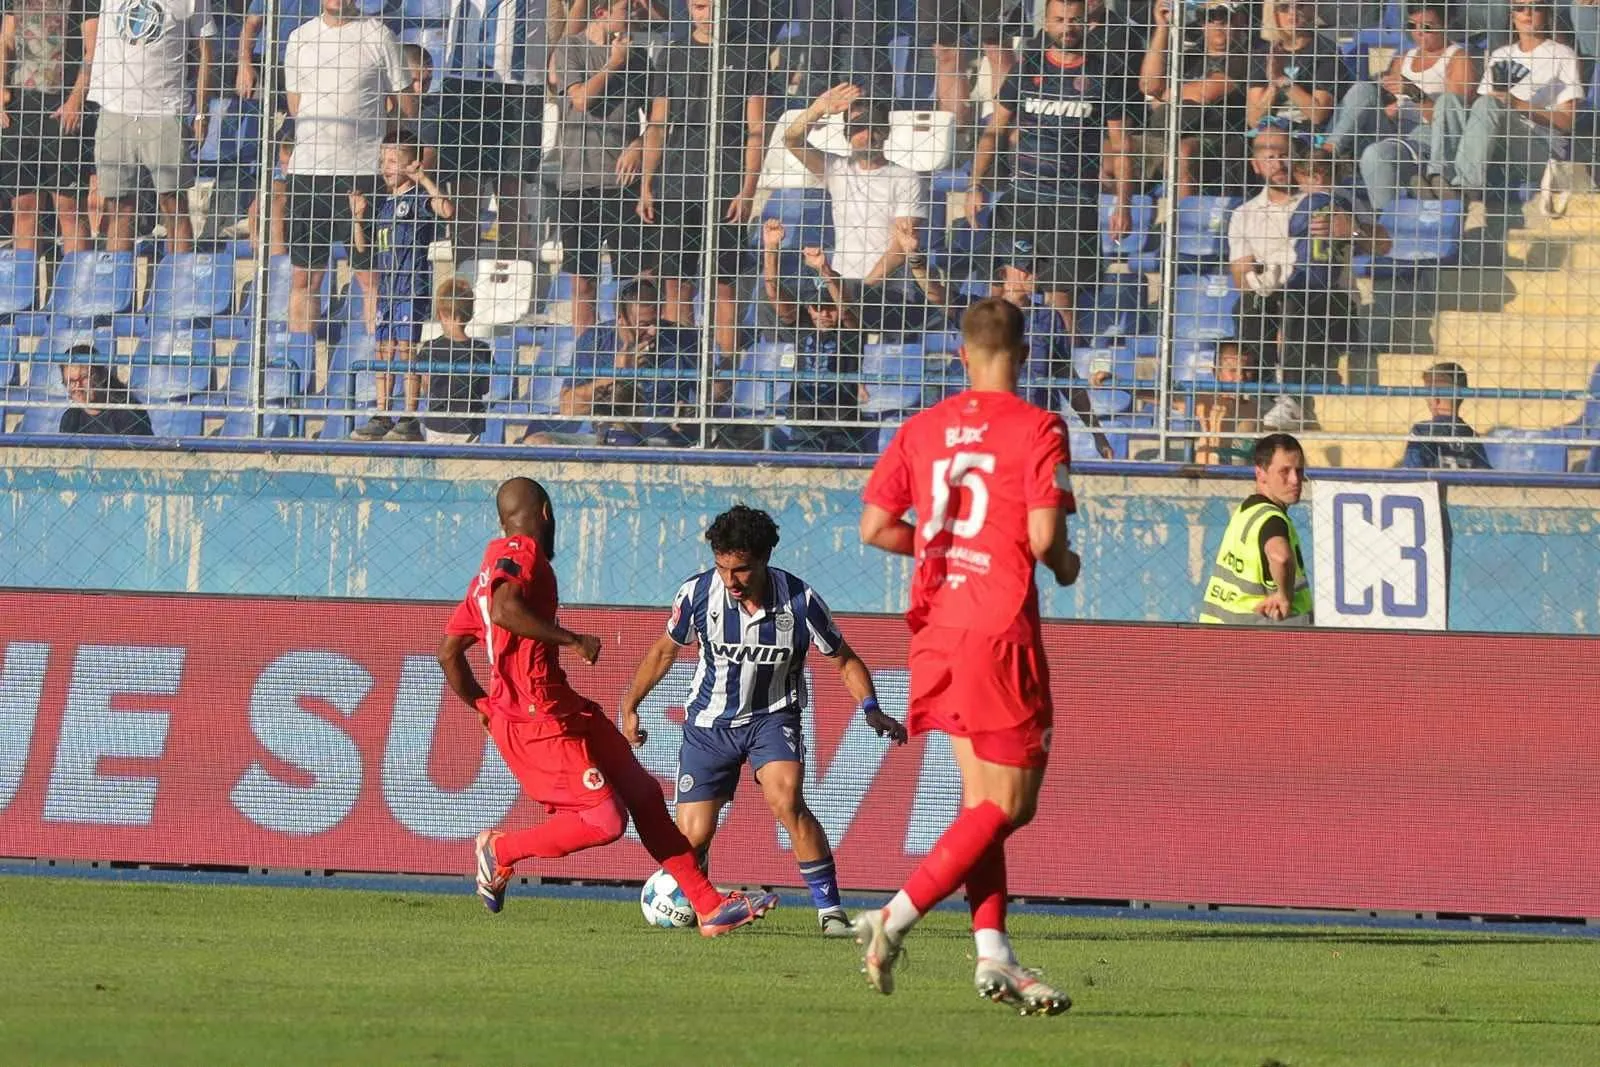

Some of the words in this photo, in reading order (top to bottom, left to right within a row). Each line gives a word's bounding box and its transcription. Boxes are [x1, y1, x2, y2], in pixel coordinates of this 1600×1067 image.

[922, 452, 996, 542] 15
[229, 647, 521, 842] SU
[655, 901, 691, 923] SELECT
